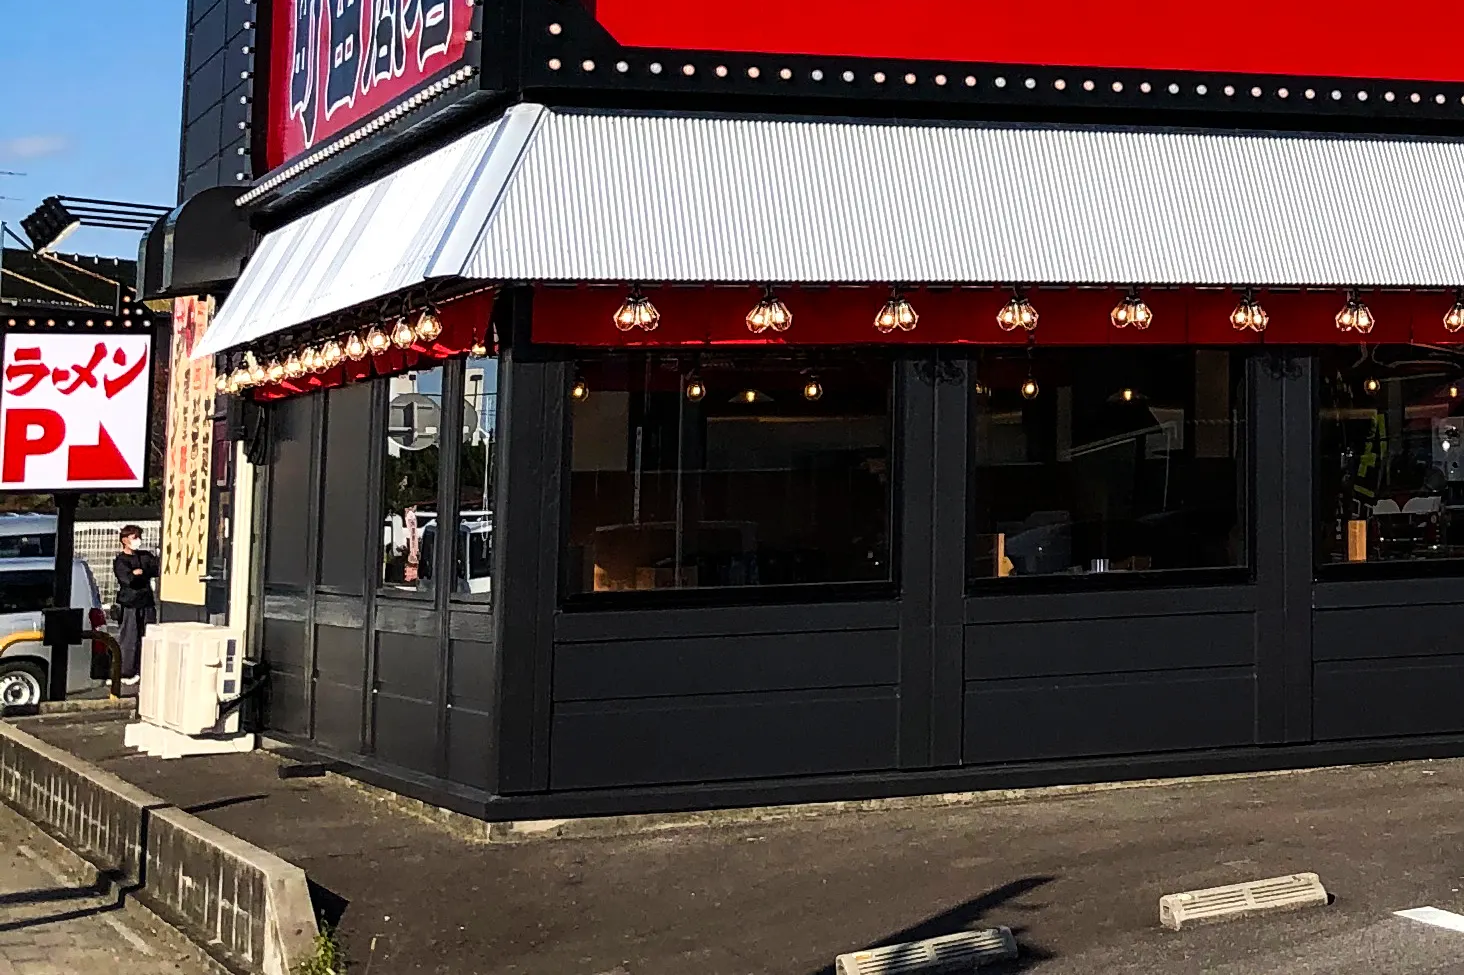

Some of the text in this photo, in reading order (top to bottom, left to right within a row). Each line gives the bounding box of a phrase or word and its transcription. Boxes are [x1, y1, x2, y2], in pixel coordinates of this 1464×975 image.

[5, 342, 148, 400] ラーメン
[2, 408, 66, 483] P
